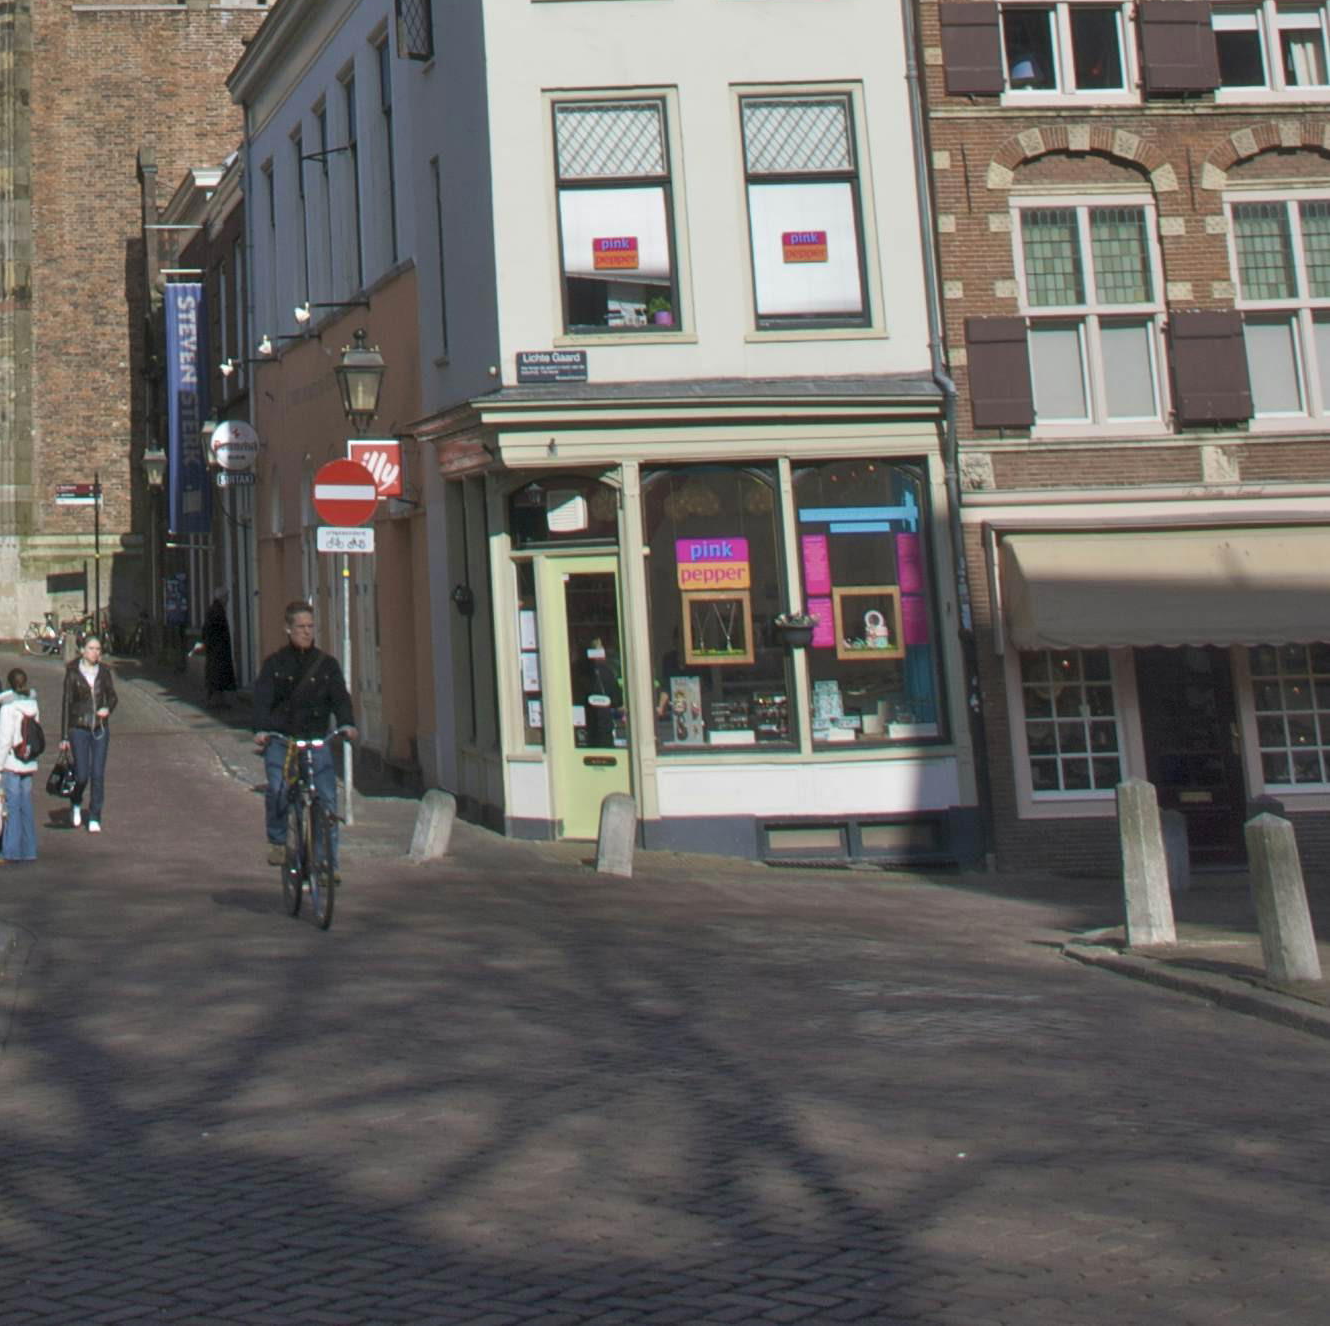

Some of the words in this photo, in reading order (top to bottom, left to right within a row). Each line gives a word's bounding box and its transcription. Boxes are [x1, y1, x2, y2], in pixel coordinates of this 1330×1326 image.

[601, 237, 630, 250] pink
[790, 232, 818, 244] pink
[177, 296, 198, 384] STEVEN
[522, 353, 550, 363] Lichte
[552, 352, 581, 362] Gaard
[181, 392, 201, 468] STERK
[691, 540, 733, 561] pink
[681, 568, 746, 584] pepper
